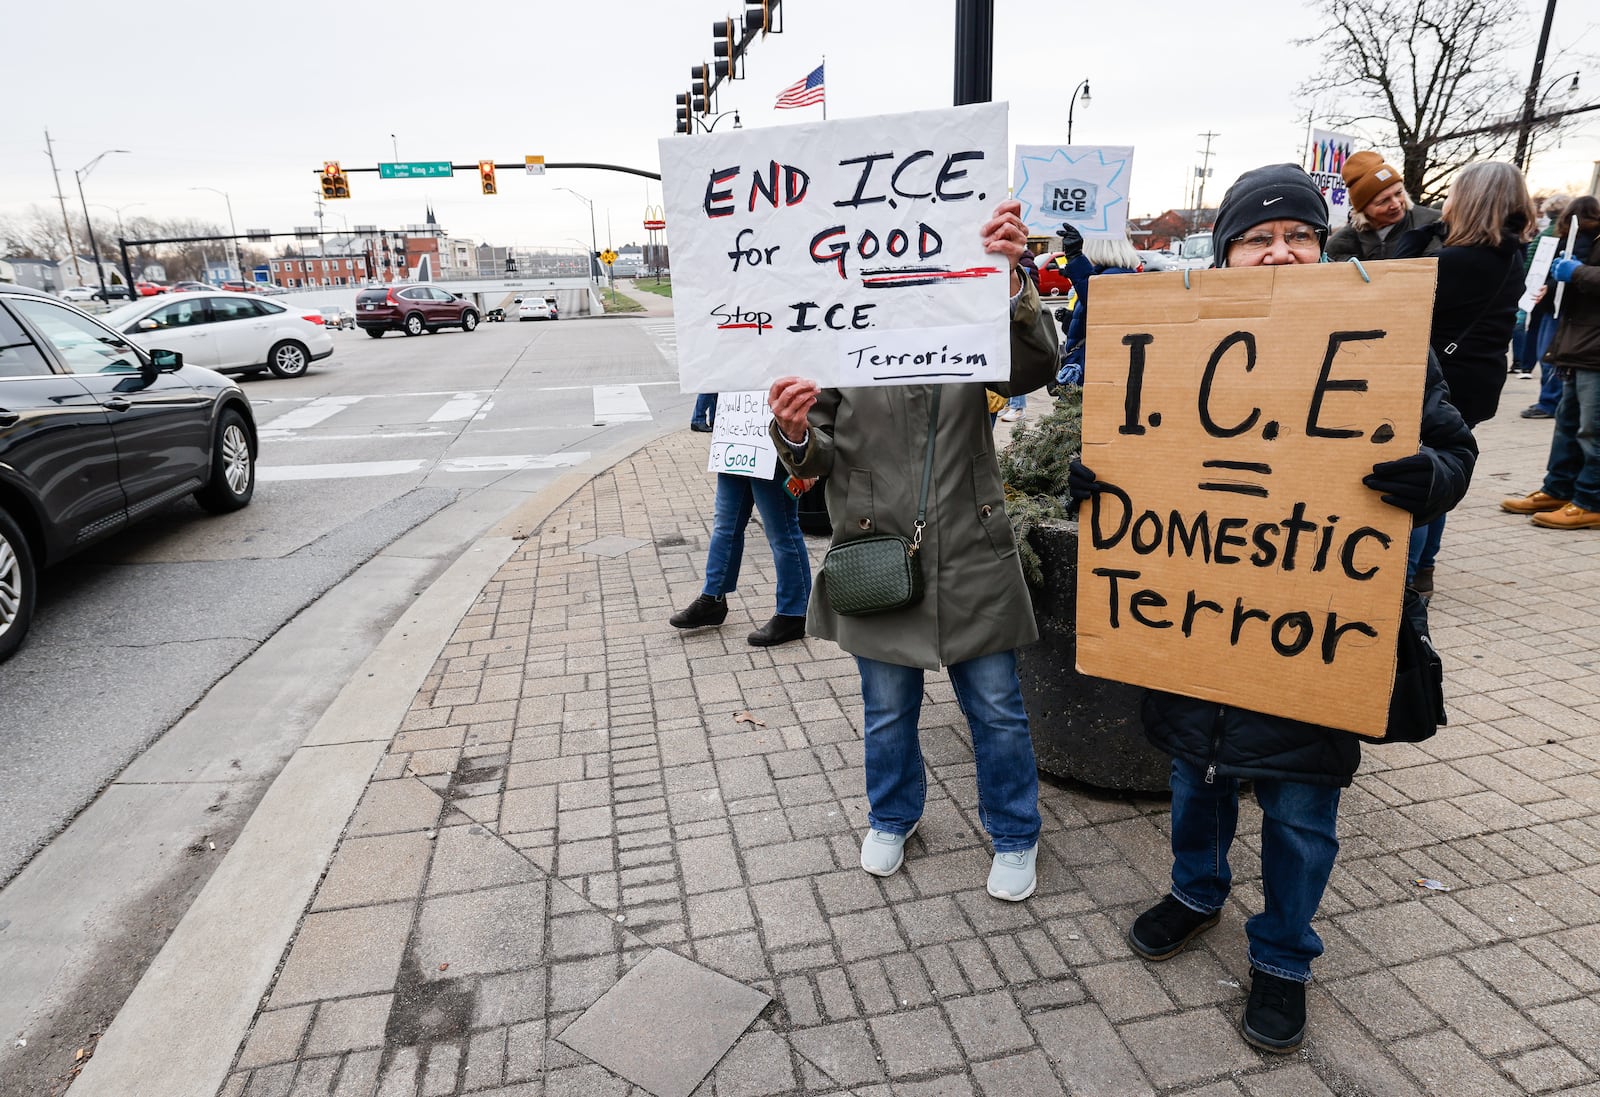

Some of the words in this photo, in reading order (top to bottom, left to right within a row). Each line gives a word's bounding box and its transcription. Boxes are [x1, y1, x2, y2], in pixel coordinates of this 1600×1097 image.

[411, 166, 426, 175] King
[428, 166, 435, 174] Jr
[1310, 172, 1345, 189] TOGETHE
[704, 160, 810, 219] END
[833, 150, 986, 210] I.C.E.
[1053, 187, 1087, 201] NO
[1052, 199, 1087, 212] ICE
[728, 229, 780, 272] for
[810, 222, 943, 280] GOOD
[710, 304, 772, 335] Stop
[786, 302, 877, 332] I.C.E.
[848, 345, 987, 368] Terrorism
[1118, 330, 1395, 444] I.C.E.
[744, 394, 758, 413] Be
[718, 417, 769, 437] Police-Stat
[724, 444, 757, 467] Good
[1092, 567, 1378, 664] Terror
